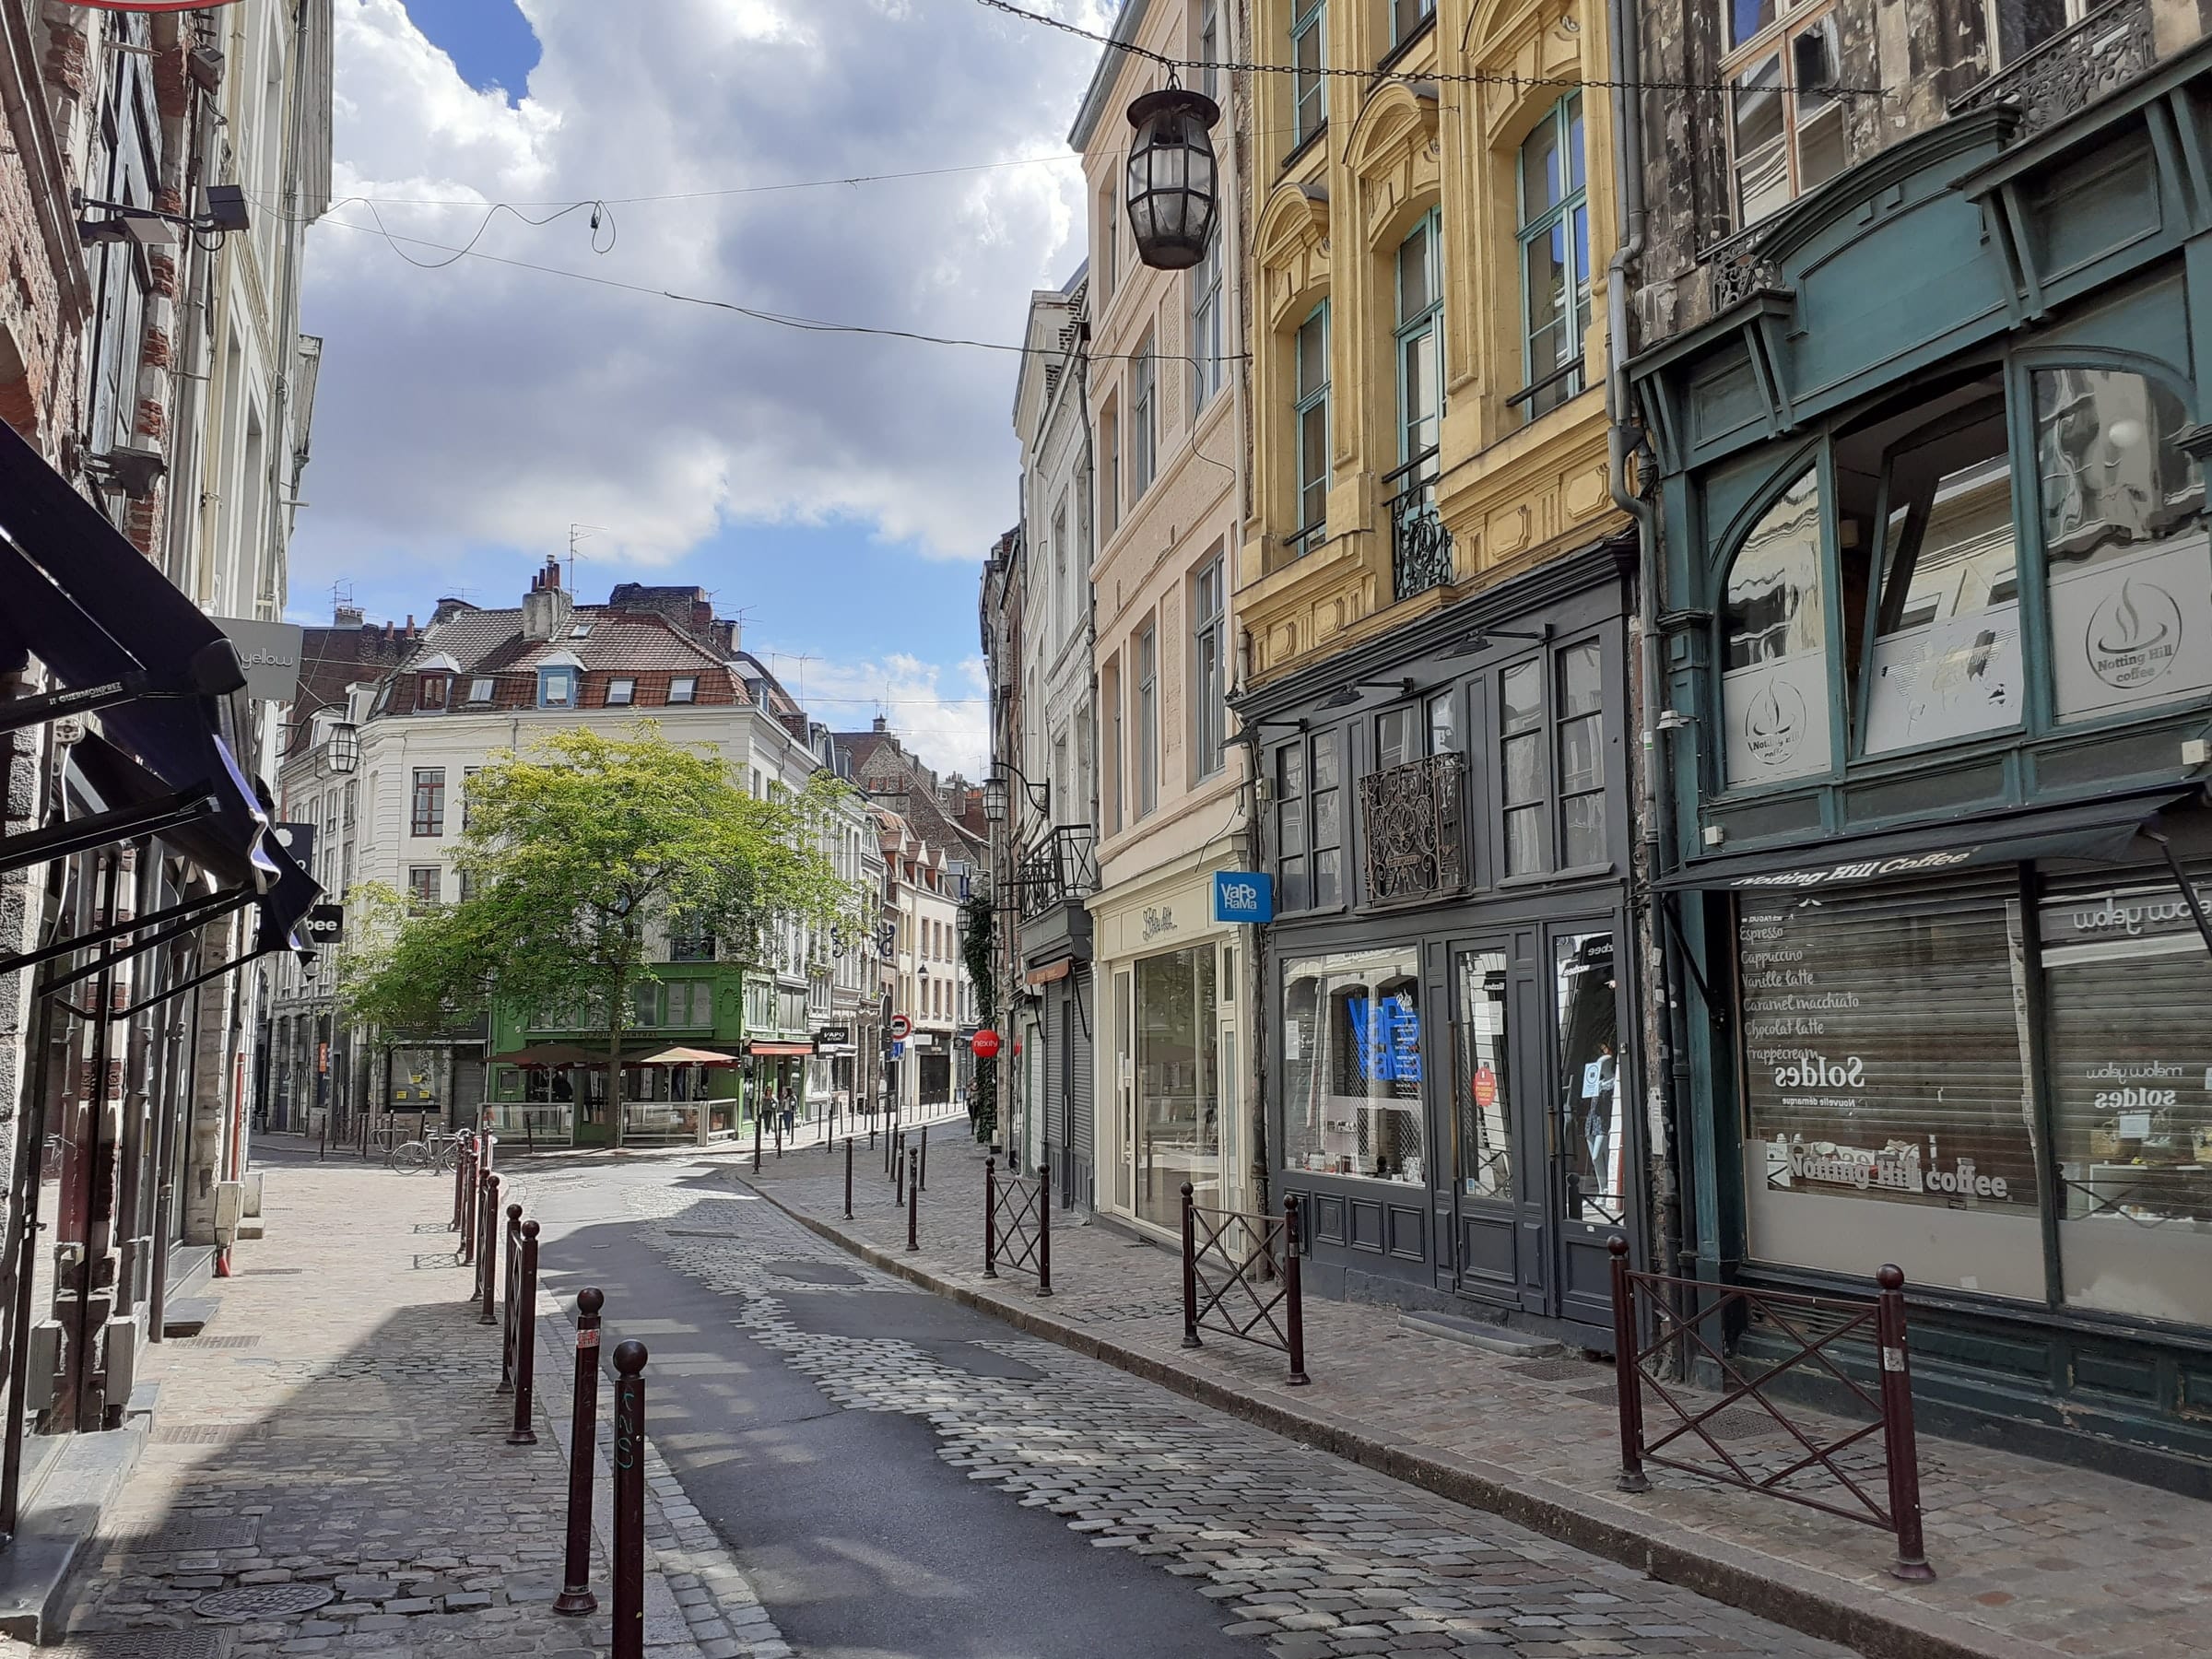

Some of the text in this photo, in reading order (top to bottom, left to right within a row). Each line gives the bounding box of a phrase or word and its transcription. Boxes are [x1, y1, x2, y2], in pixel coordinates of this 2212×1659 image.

[241, 648, 293, 669] yellow
[2098, 644, 2173, 672] Notting Hill
[2116, 667, 2155, 682] coffee
[59, 682, 122, 702] GUERMONPREZ
[1730, 852, 1971, 887] Notting Hill Coffee
[1740, 925, 1783, 945] Espresso
[1741, 946, 1803, 969] Cappuccino
[1742, 969, 1814, 988] Vanille latte
[1743, 991, 1859, 1011] Caramel macchiato
[1745, 1018, 1825, 1039] Chocolat latte
[974, 1040, 998, 1048] nexity
[1788, 1153, 2008, 1197] Notting Hill coffee
